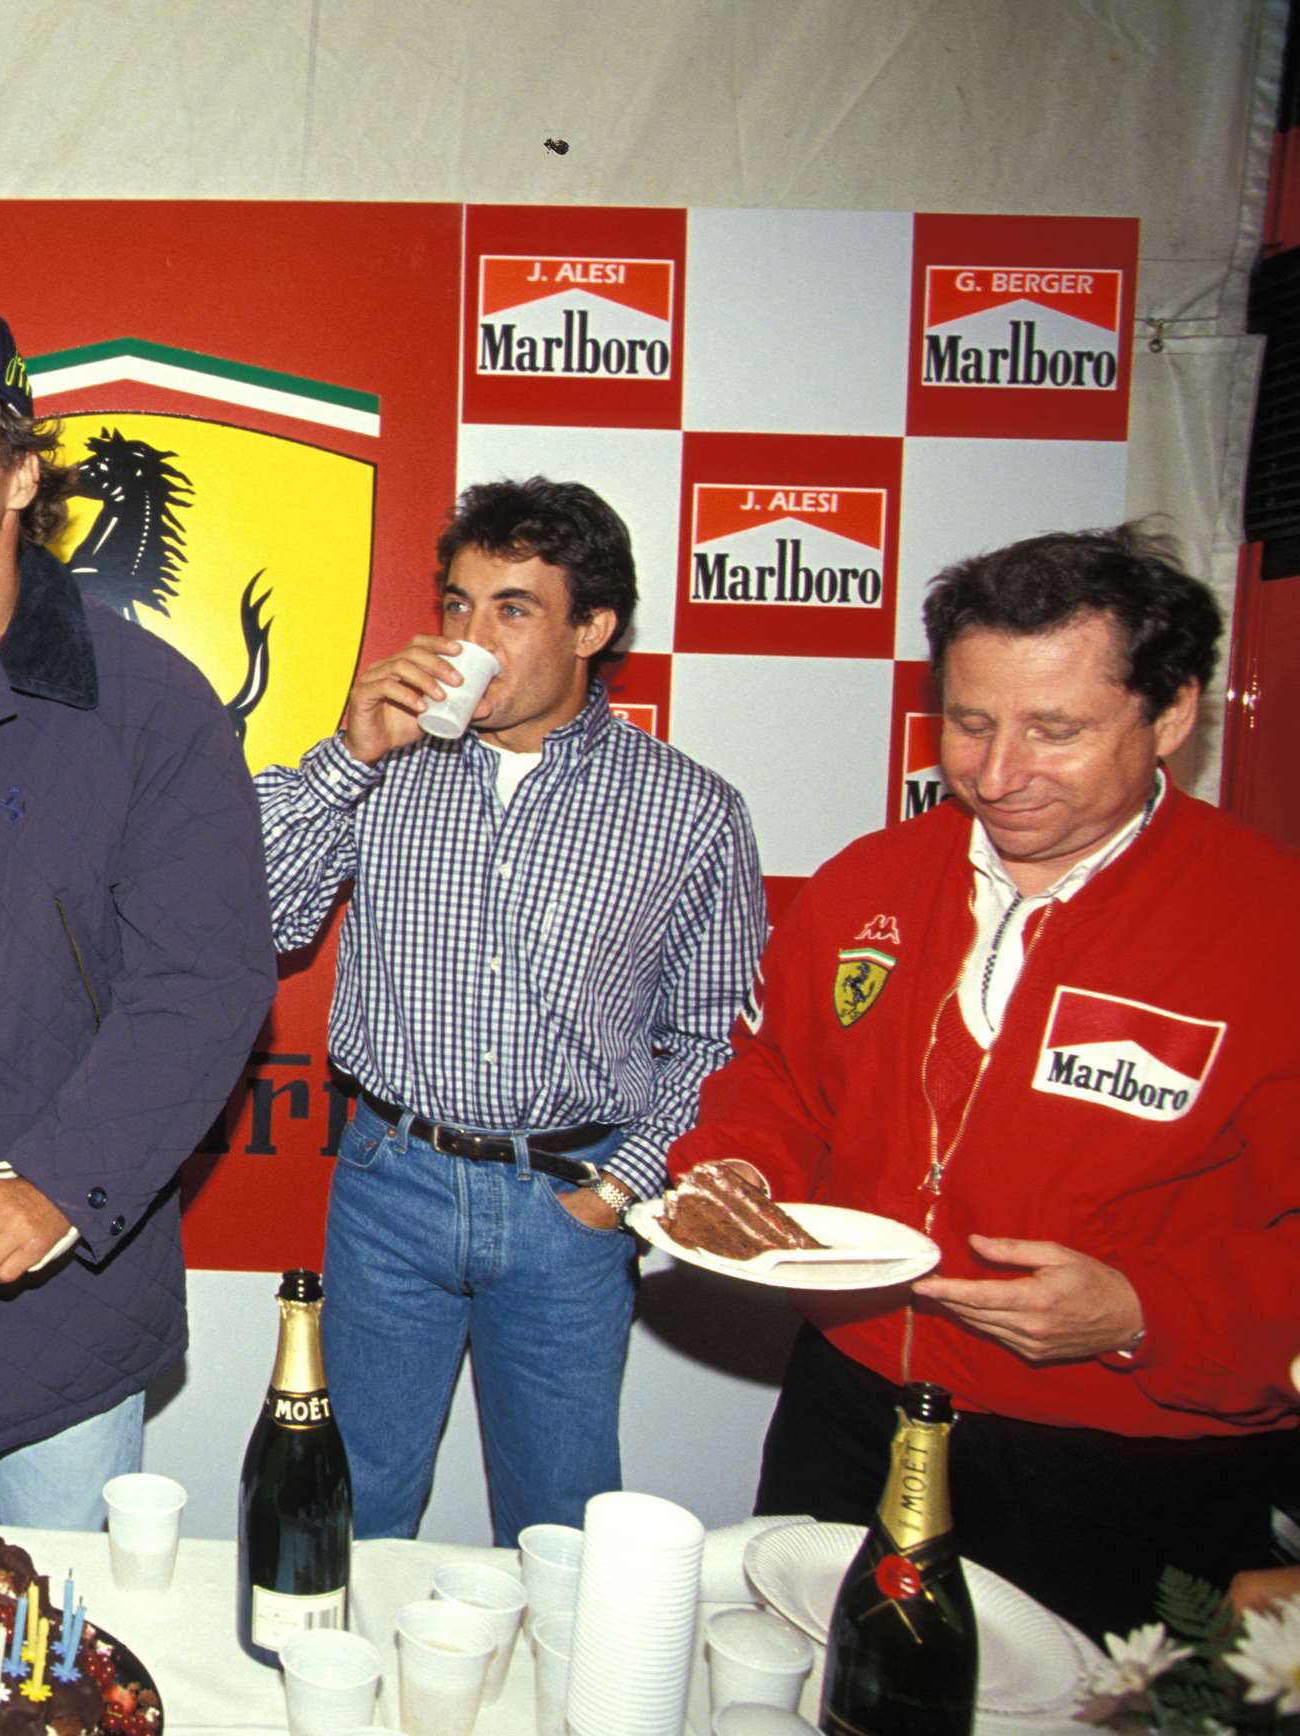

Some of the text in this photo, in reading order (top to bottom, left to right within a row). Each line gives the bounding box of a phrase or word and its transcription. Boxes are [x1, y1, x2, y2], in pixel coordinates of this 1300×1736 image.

[527, 262, 626, 284] J. ALESI
[955, 271, 1094, 294] G. BERGER
[479, 309, 670, 375] Marlboro
[923, 320, 1116, 387] Marlboro
[740, 490, 838, 512] J. ALESI
[692, 538, 881, 604] Marlboro
[1046, 1050, 1189, 1111] Marlboro
